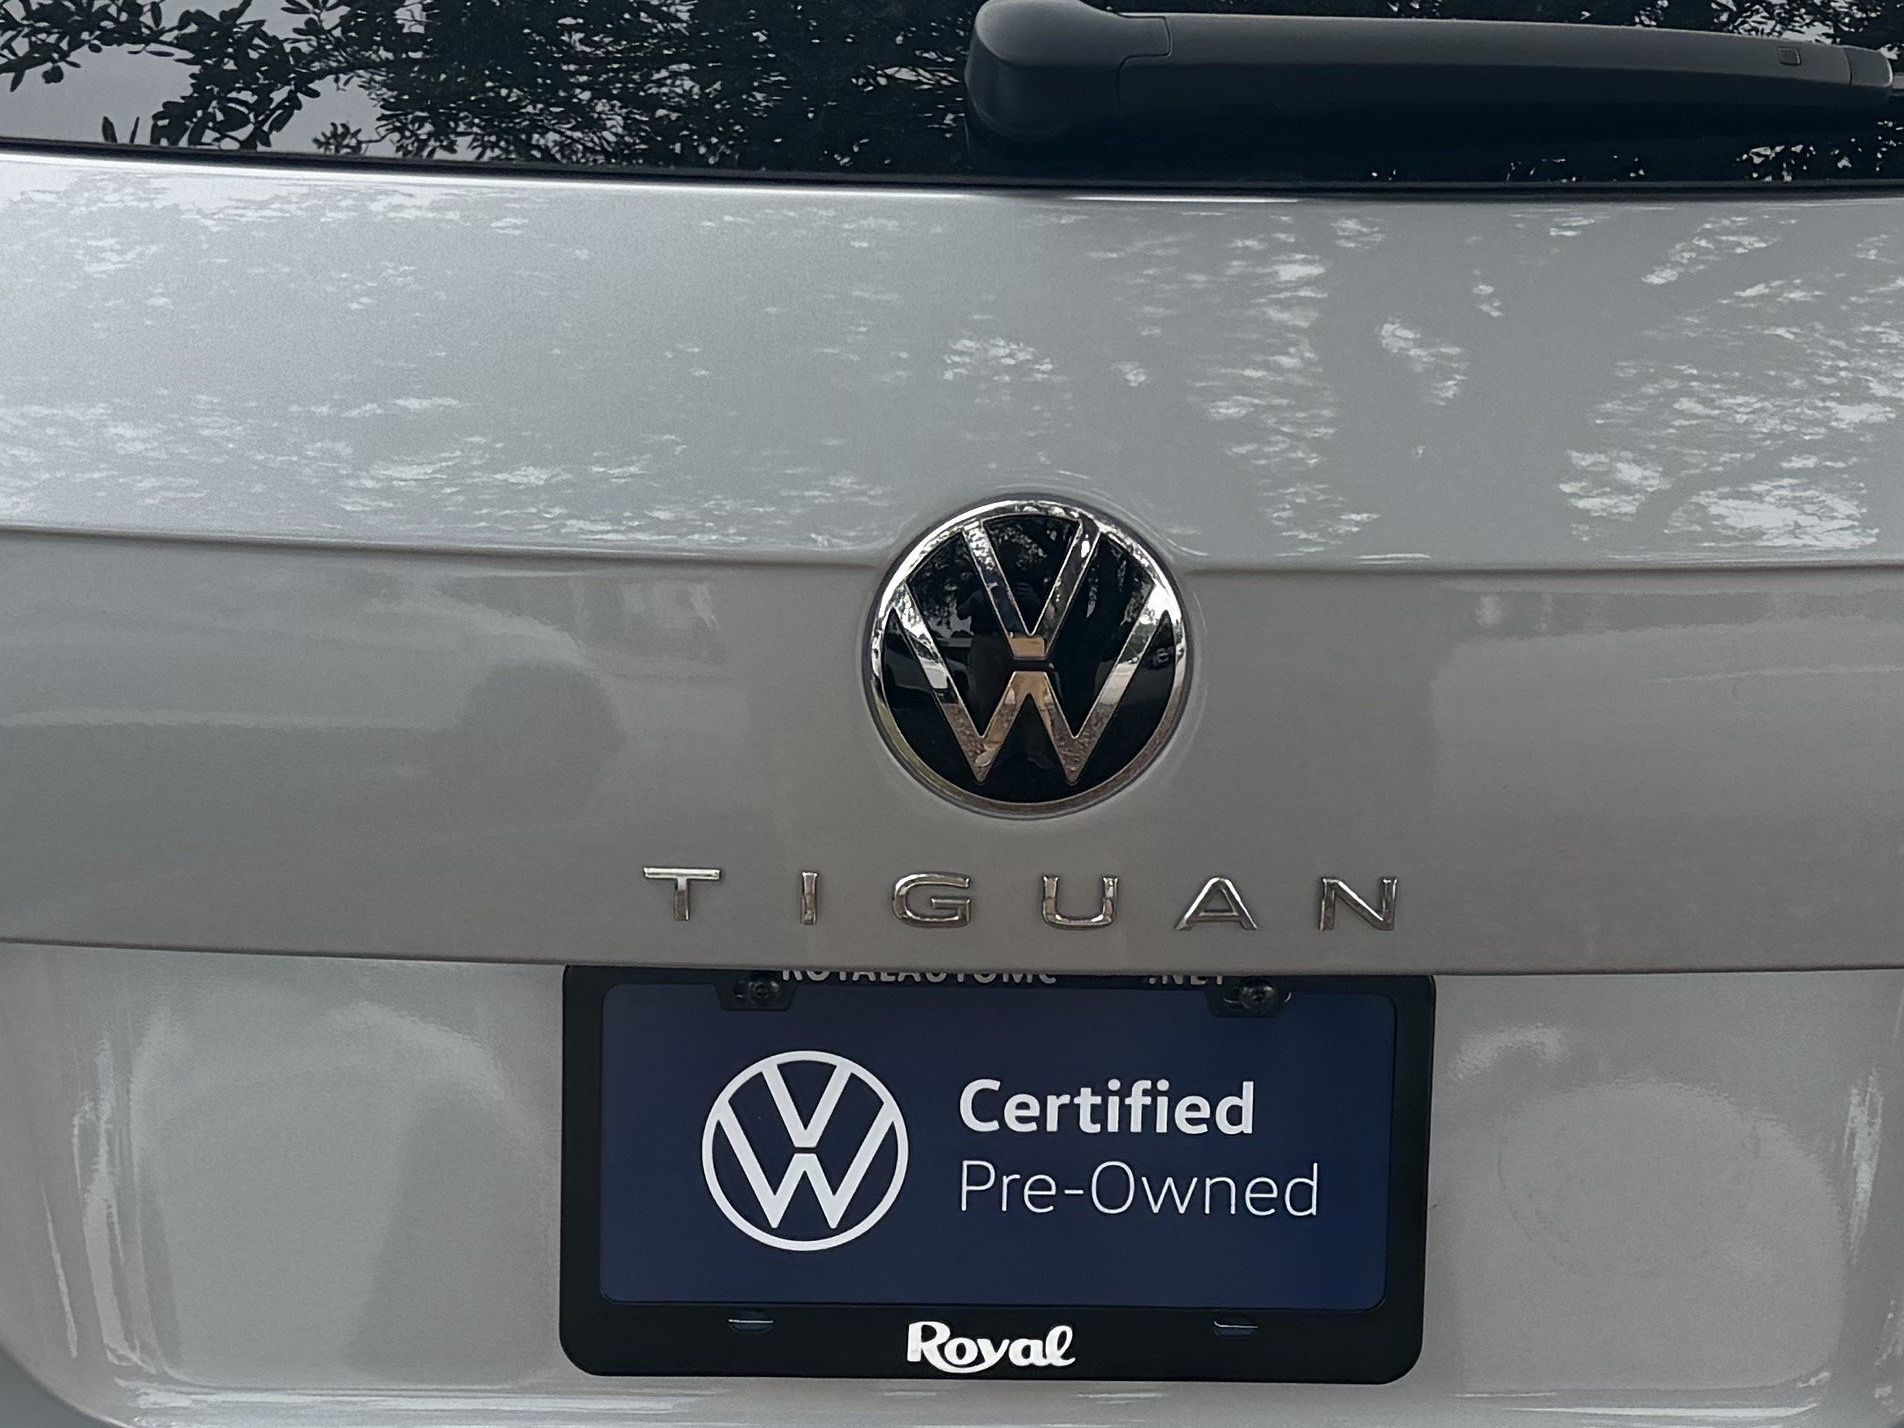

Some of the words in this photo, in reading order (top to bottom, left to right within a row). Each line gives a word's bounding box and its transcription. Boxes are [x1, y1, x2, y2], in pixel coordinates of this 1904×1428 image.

[642, 865, 1400, 933] TIGUAN
[959, 1078, 1256, 1135] Certified
[960, 1159, 1320, 1217] Pre-Owned
[906, 1321, 1077, 1374] Royal
